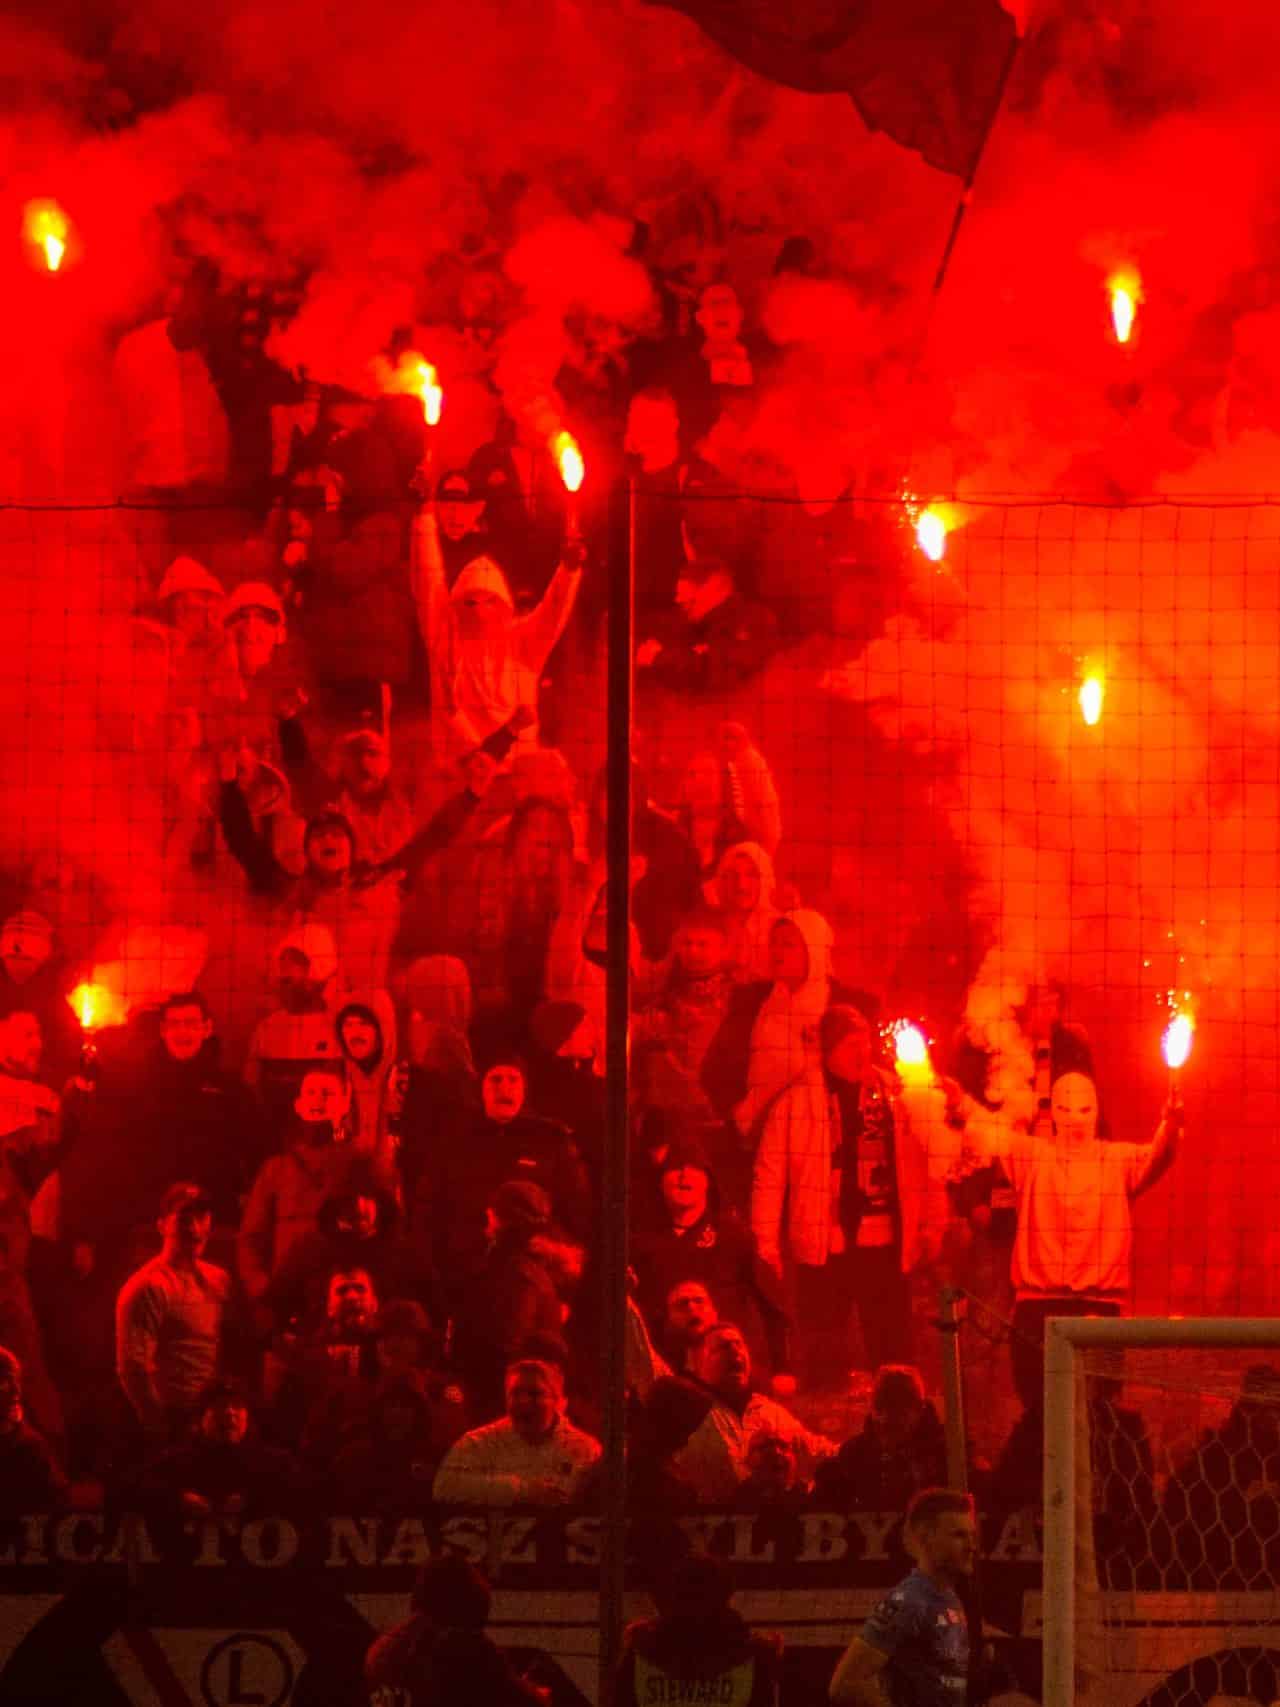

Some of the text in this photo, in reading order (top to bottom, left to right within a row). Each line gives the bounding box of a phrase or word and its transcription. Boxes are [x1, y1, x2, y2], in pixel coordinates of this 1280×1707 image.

[182, 1515, 299, 1568] TO
[324, 1515, 538, 1568] NASZ
[563, 1513, 776, 1567] SYL
